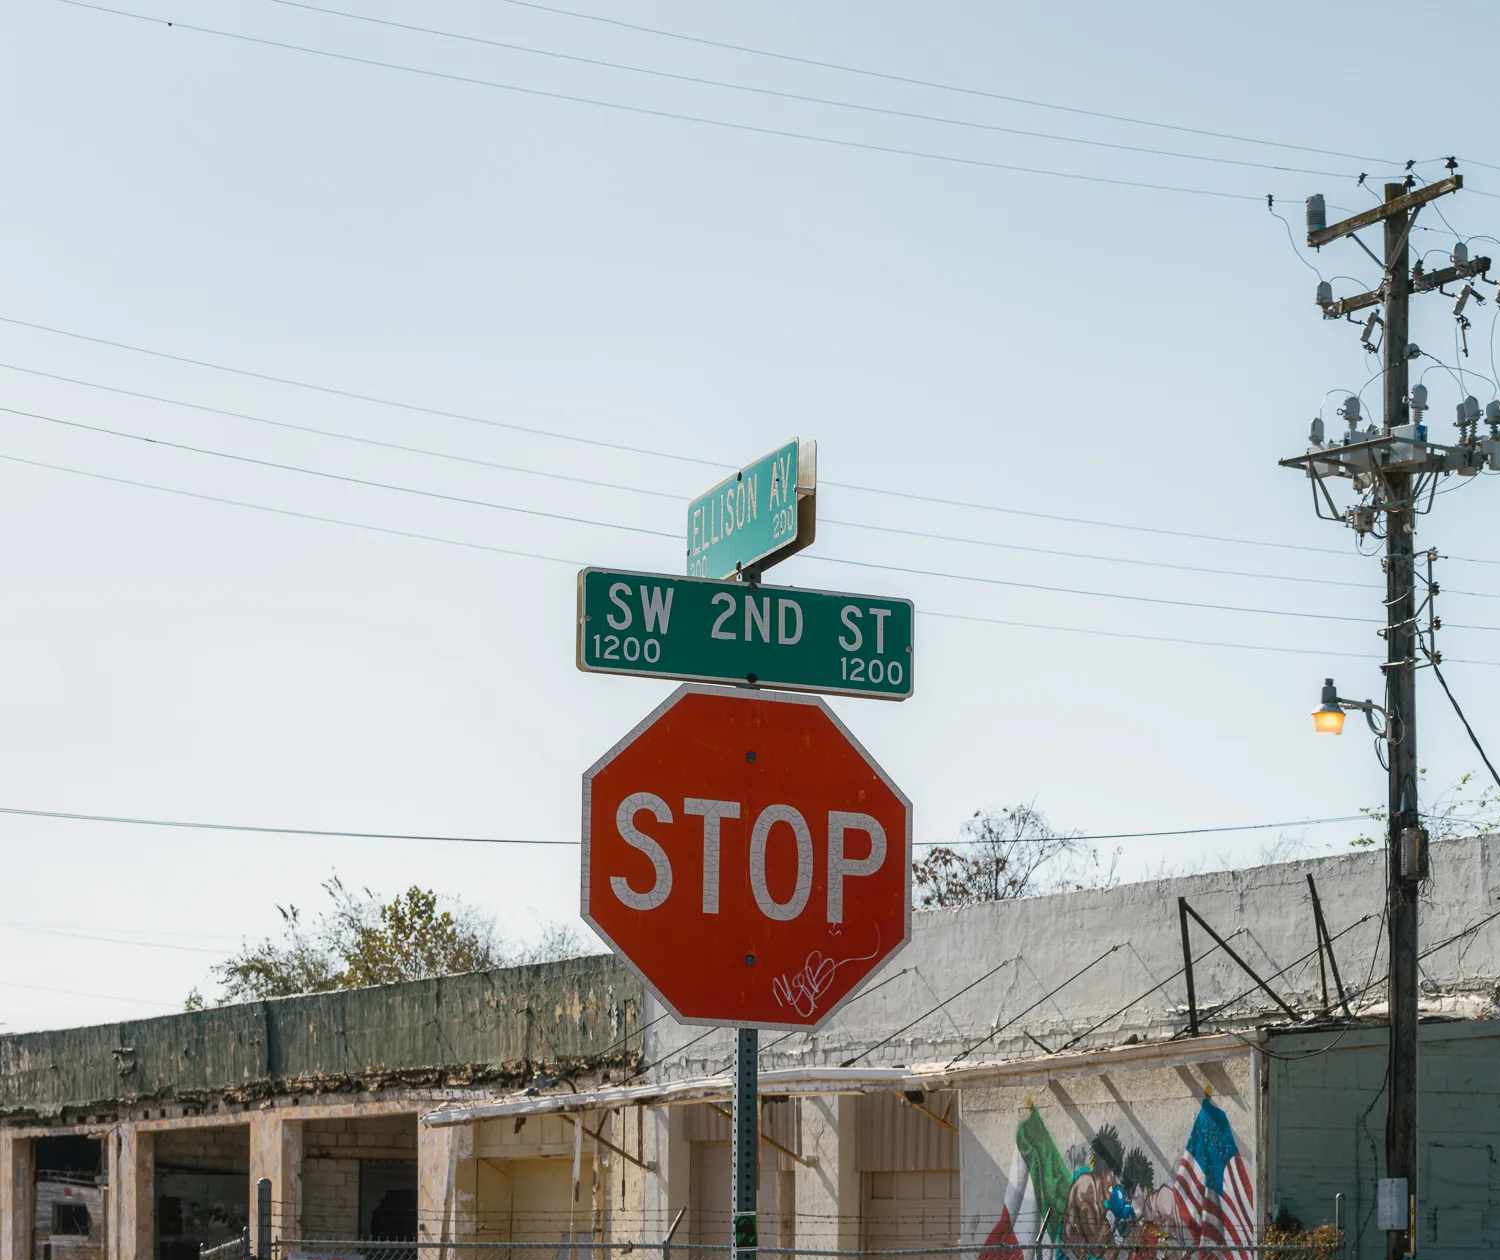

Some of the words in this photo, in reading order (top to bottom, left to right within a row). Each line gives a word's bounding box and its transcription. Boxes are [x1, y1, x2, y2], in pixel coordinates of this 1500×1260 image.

[692, 473, 757, 556] ELLISON
[769, 453, 791, 511] AV
[773, 505, 794, 539] 200
[607, 582, 674, 635] SW
[711, 592, 803, 645] 2ND
[838, 605, 892, 654] ST
[594, 634, 661, 663] 1200
[840, 656, 903, 685] 1200
[610, 791, 887, 924] STOP
